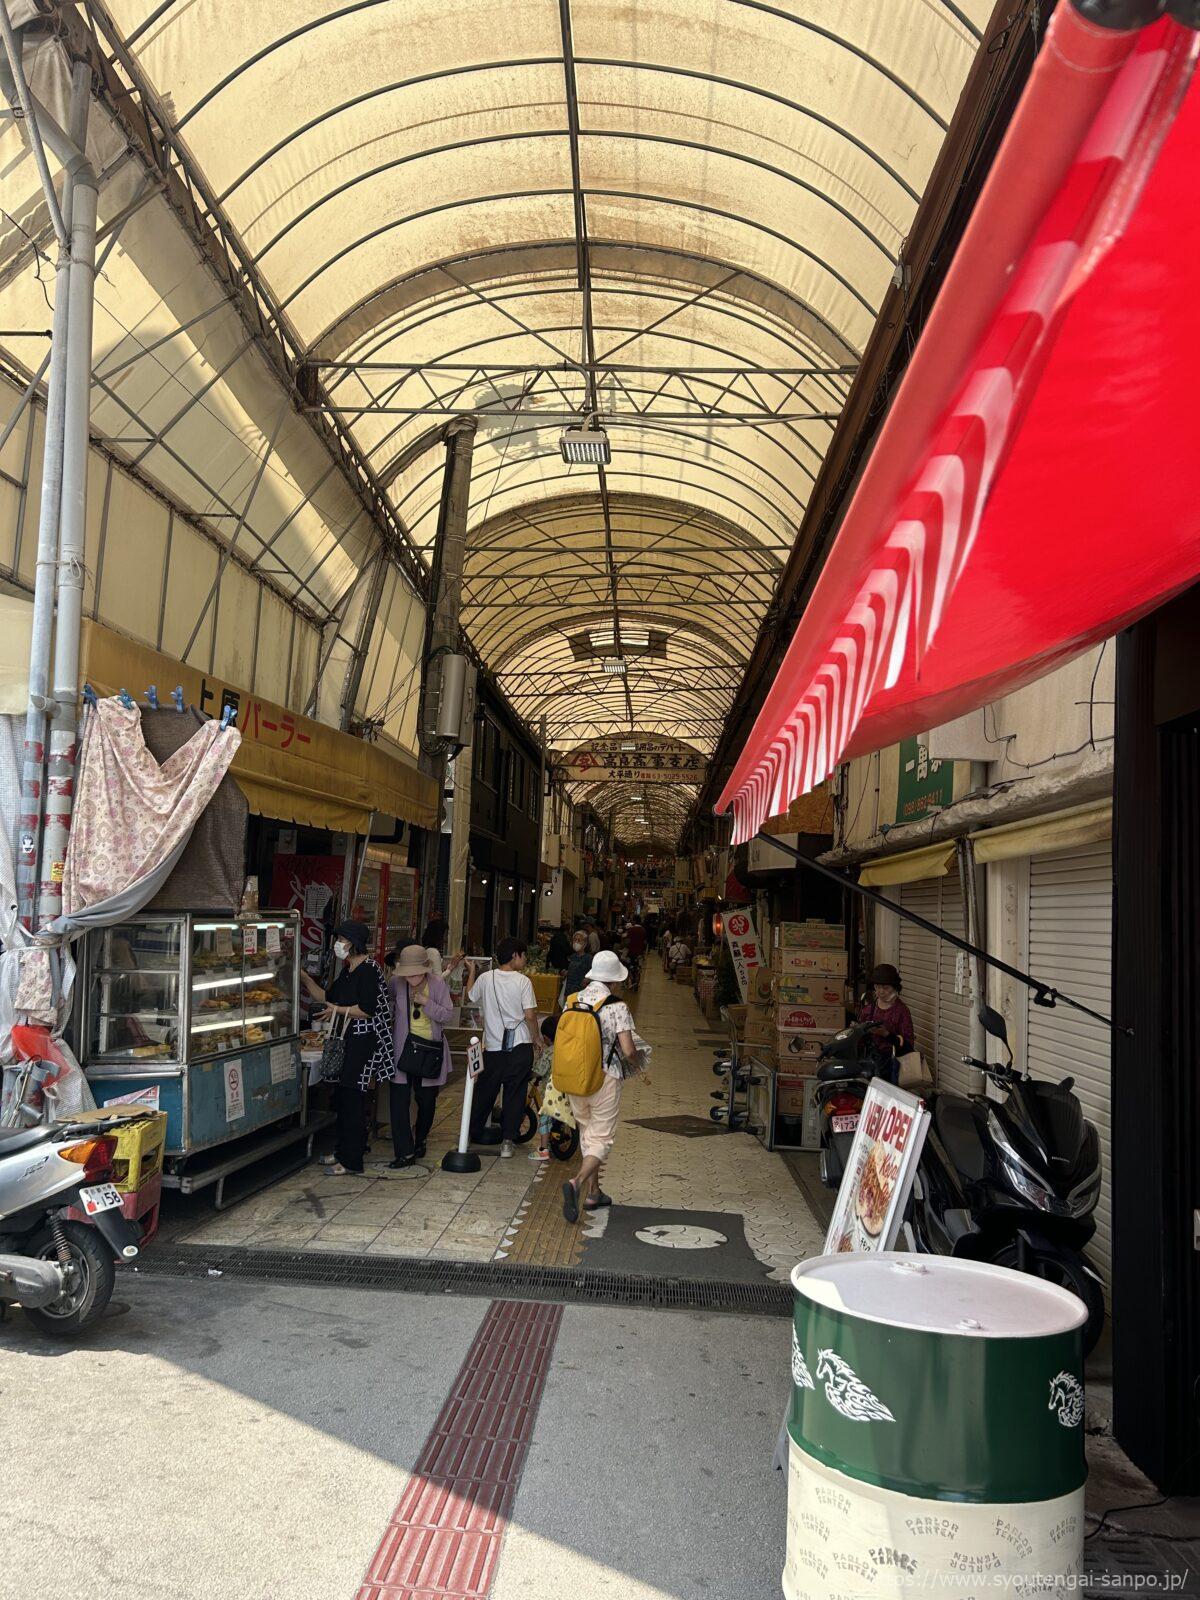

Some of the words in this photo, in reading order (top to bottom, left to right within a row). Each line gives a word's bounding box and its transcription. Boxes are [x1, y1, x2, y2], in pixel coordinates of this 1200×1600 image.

[863, 1101, 889, 1142] NEW
[905, 1516, 959, 1533] PARLOR
[909, 1526, 955, 1540] TENTEN
[995, 1527, 1026, 1559] TENTEN
[996, 1518, 1033, 1556] PARLOR
[950, 1559, 1001, 1573] PARLOR
[953, 1552, 998, 1565] TENTEN
[836, 1562, 874, 1582] TENTEN
